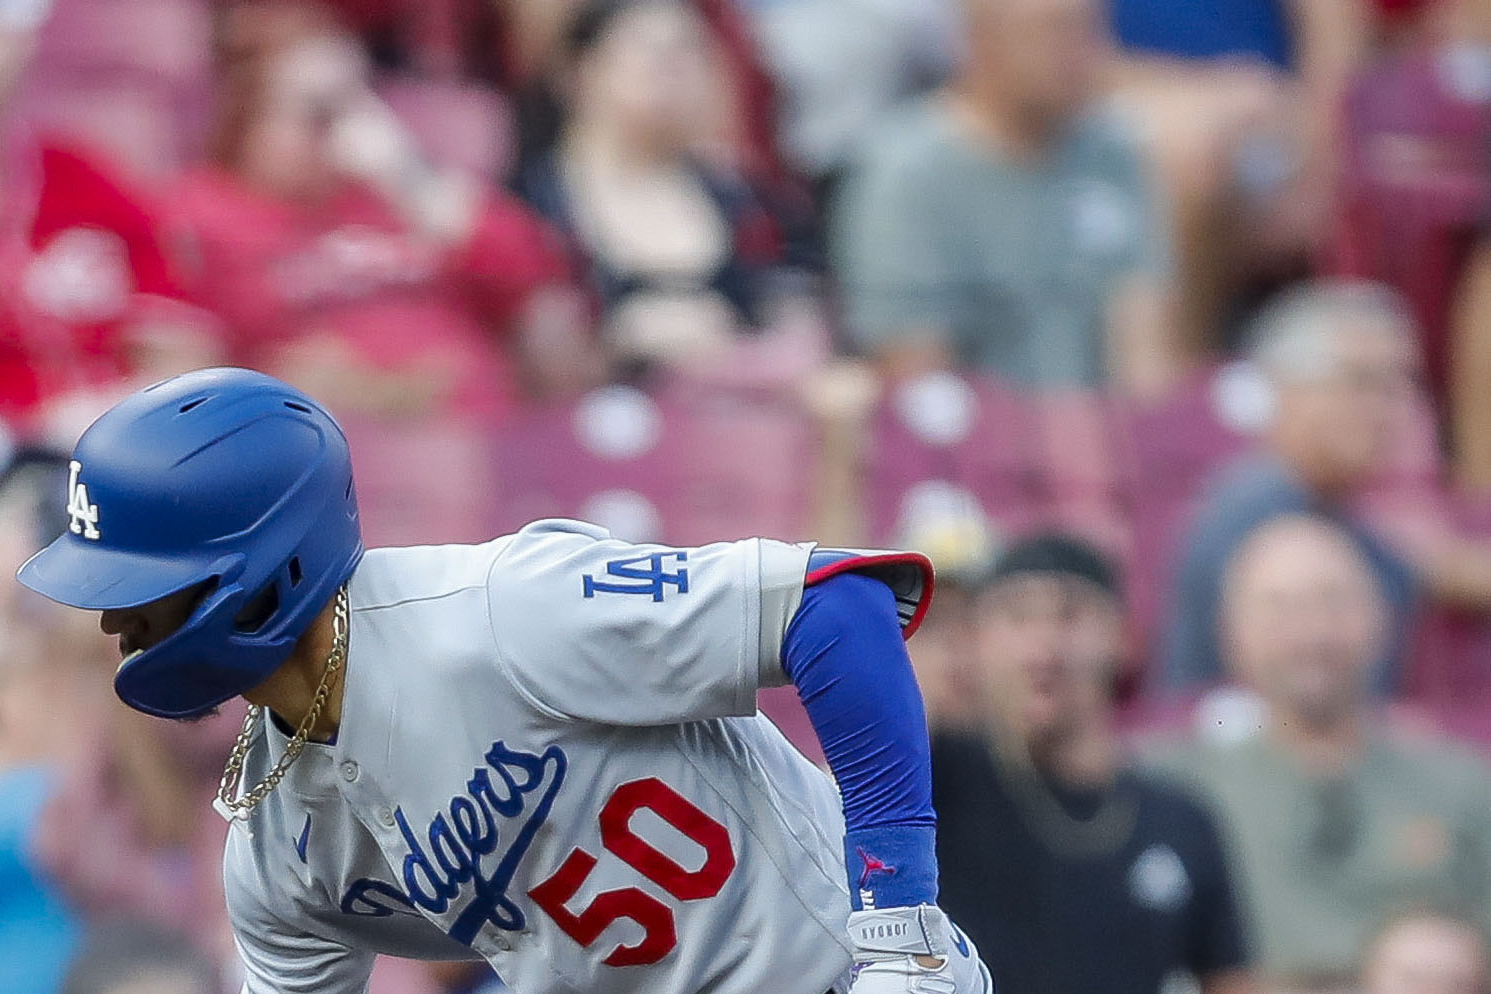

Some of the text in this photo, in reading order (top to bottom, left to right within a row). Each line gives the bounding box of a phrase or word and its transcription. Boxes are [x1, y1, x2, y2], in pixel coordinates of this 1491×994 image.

[67, 461, 100, 539] LA
[583, 552, 688, 602] LA
[341, 740, 567, 946] Ddgers
[527, 776, 736, 967] 50
[861, 922, 907, 940] JORDAN
